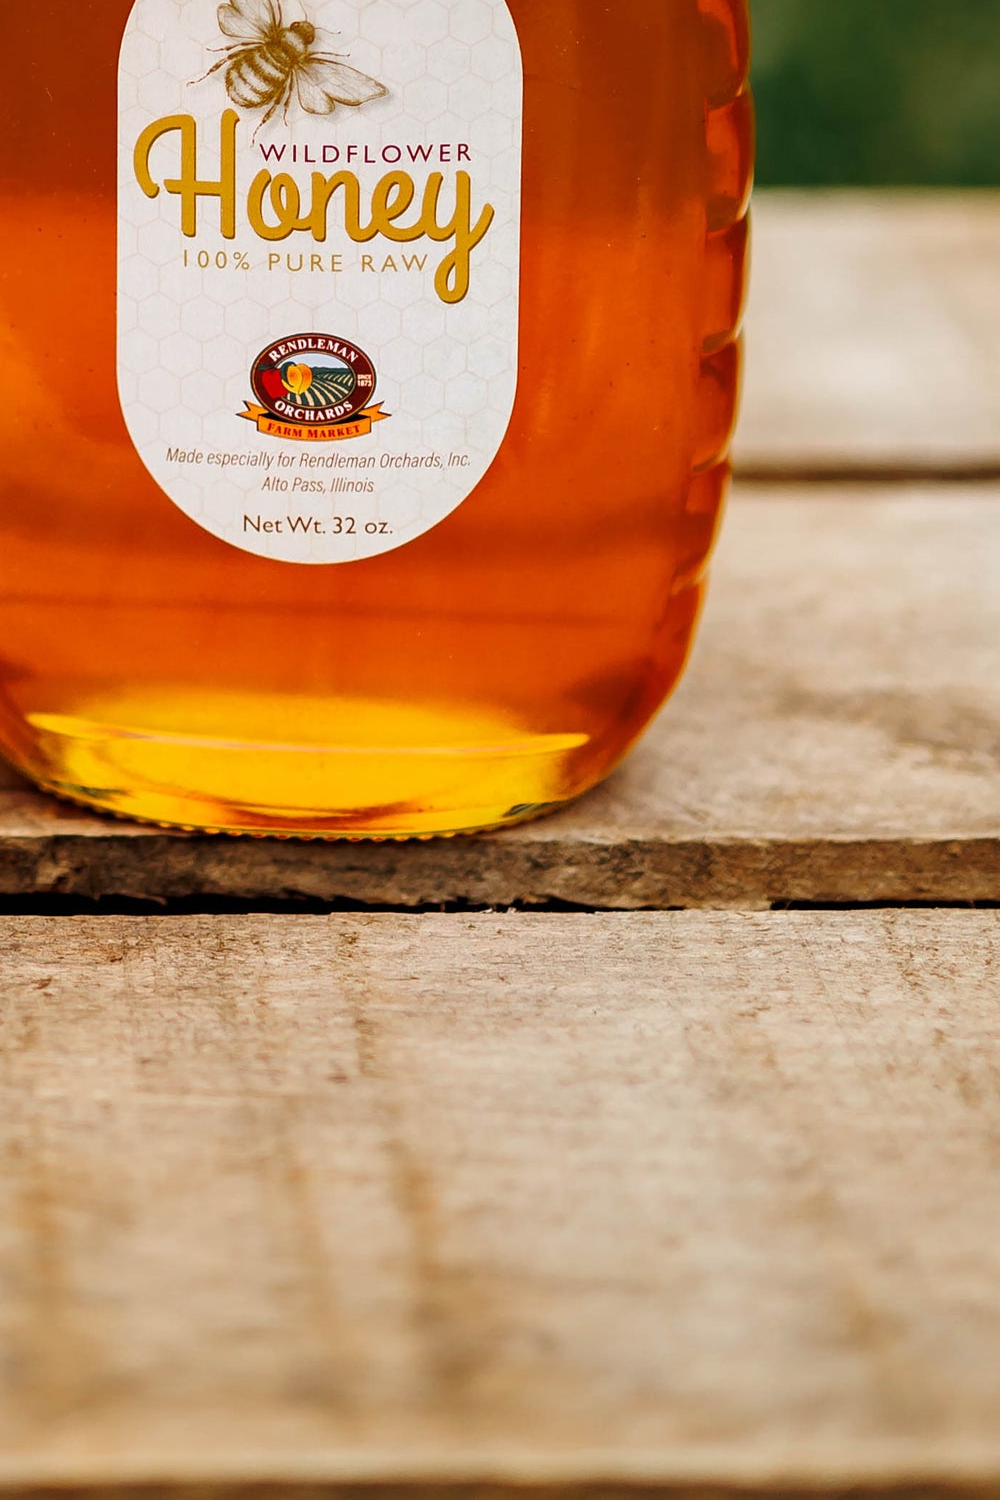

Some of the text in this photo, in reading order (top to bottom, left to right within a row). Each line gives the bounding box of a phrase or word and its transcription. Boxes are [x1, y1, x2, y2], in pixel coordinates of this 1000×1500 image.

[258, 143, 472, 164] WILDFLOWER
[133, 108, 495, 304] Honey
[183, 249, 428, 273] 100% PURE RAW
[268, 338, 359, 363] RENDLEMAN
[274, 401, 353, 421] ORCHARDS
[267, 422, 361, 439] FARM MARKET
[165, 447, 471, 470] Made especially for Rendleman Orchards, Inc.
[262, 476, 375, 494] Alto Pass, Illinois
[243, 514, 393, 534] Net Wt. 32 oz.
